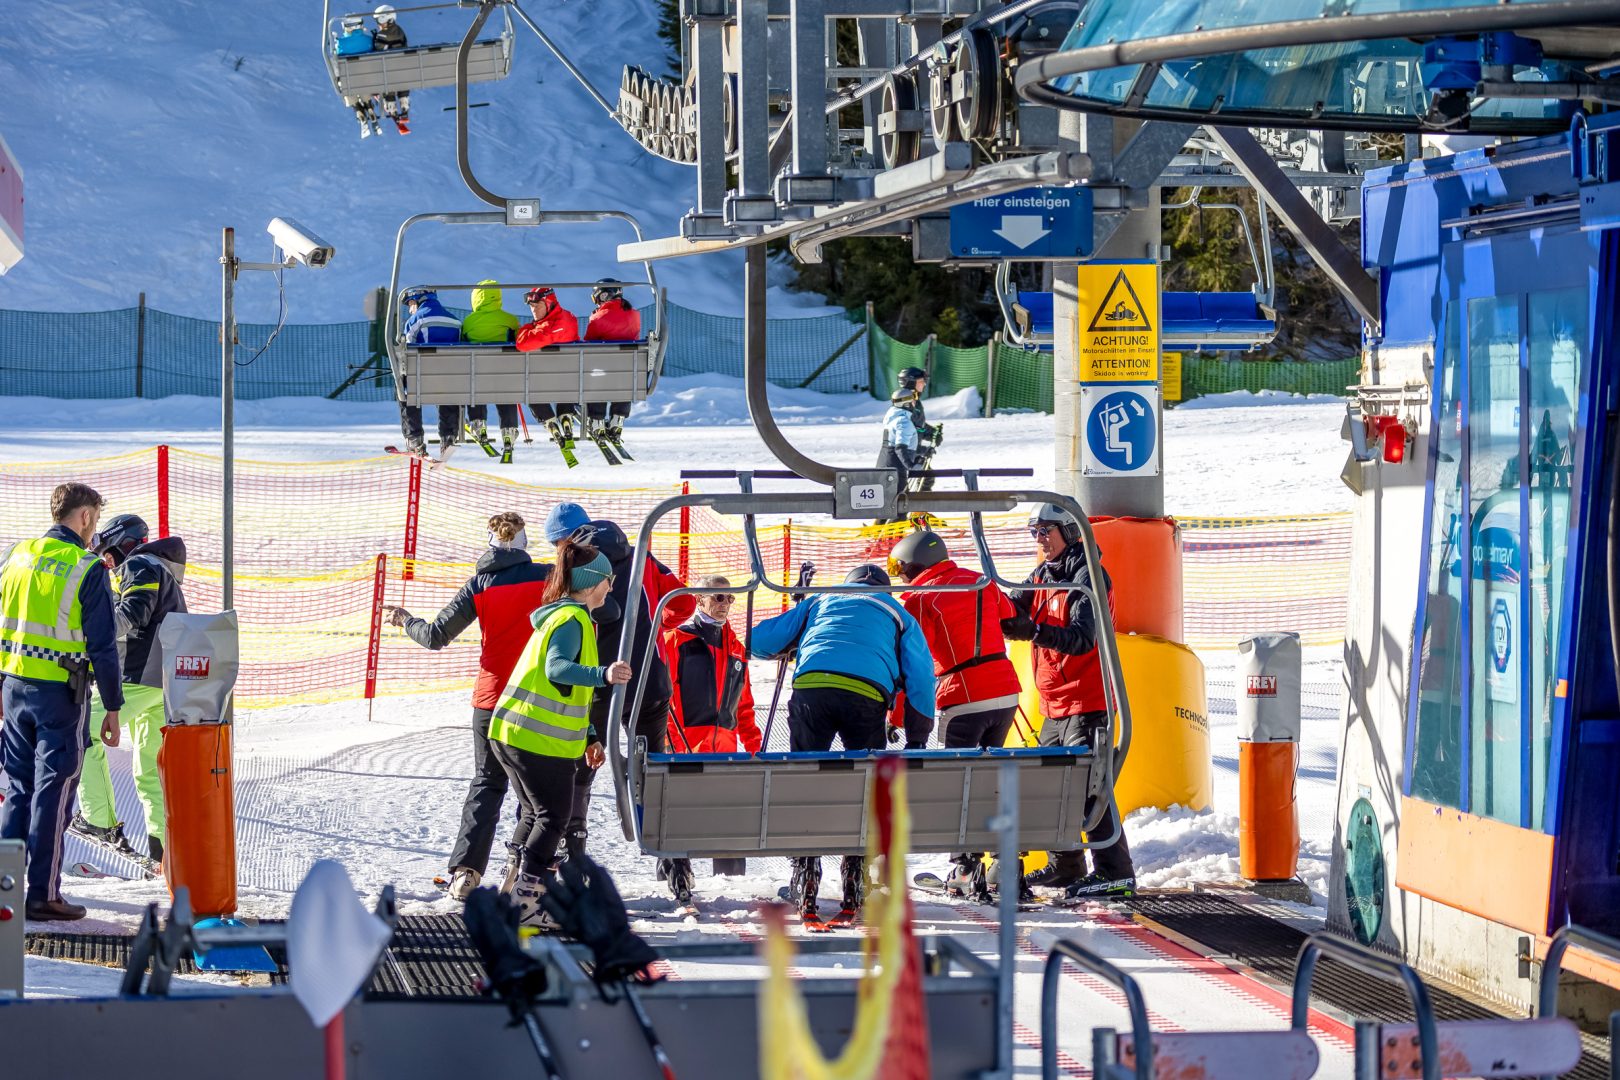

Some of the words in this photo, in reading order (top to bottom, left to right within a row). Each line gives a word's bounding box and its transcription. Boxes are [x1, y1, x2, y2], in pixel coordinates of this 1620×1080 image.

[974, 197, 1000, 207] Hier
[1004, 196, 1070, 210] einsteigen
[1093, 335, 1149, 346] ACHTUNG!
[1091, 359, 1151, 369] ATTENTION!
[859, 488, 875, 500] 43
[102, 524, 124, 538] ATOMIC
[176, 656, 209, 670] FREY
[1247, 676, 1276, 689] FREY
[1076, 877, 1134, 895] FISCHER
